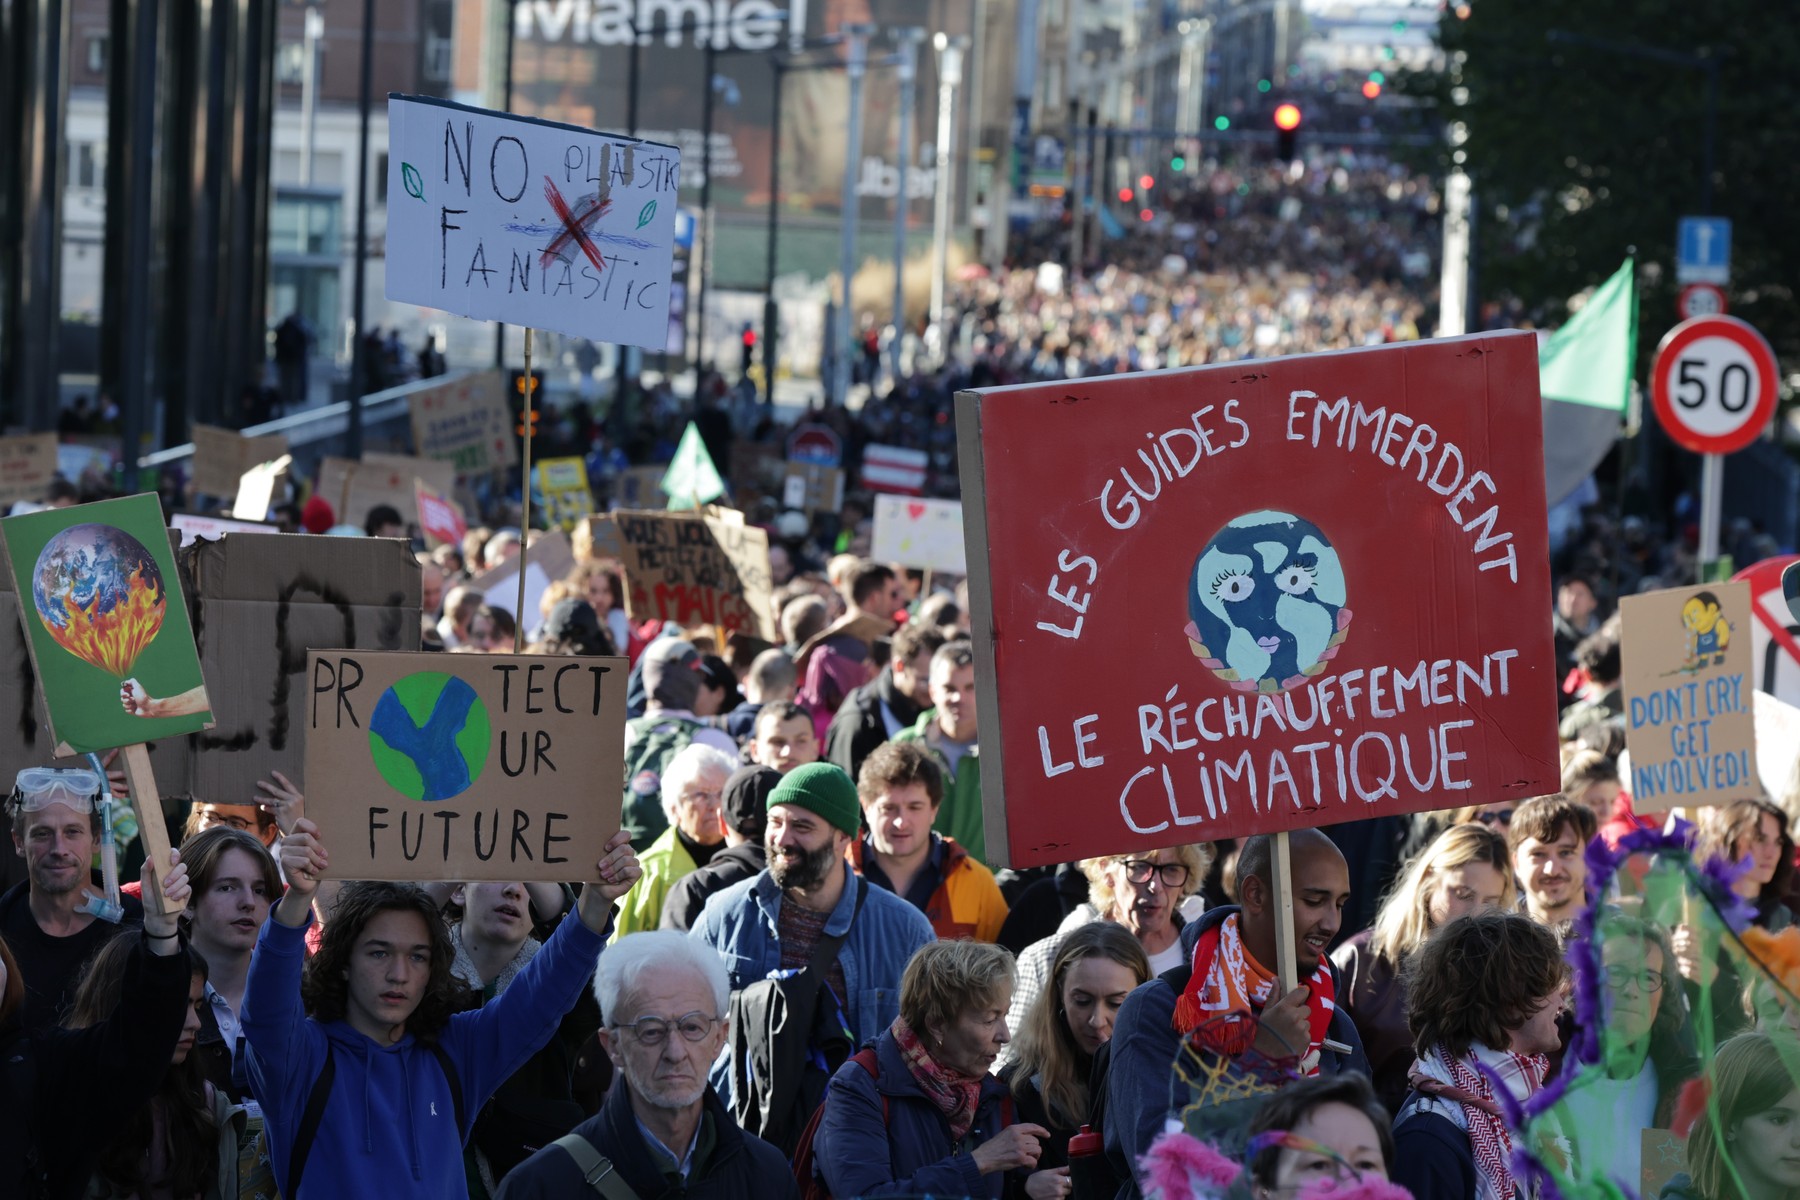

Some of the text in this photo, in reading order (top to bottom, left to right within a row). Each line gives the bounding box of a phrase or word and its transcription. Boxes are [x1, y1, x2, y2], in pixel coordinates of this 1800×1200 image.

[444, 118, 529, 203] NO
[1677, 360, 1751, 414] 50
[1036, 548, 1098, 640] LES
[1286, 389, 1518, 584] EMMERDENT
[653, 580, 717, 625] MAI
[1037, 649, 1519, 778] LE RÉCHAUFFEMENT
[1630, 672, 1748, 729] DON'T CRY,
[501, 730, 557, 778] UR
[1671, 719, 1712, 758] GET
[368, 807, 572, 864] FUTURE
